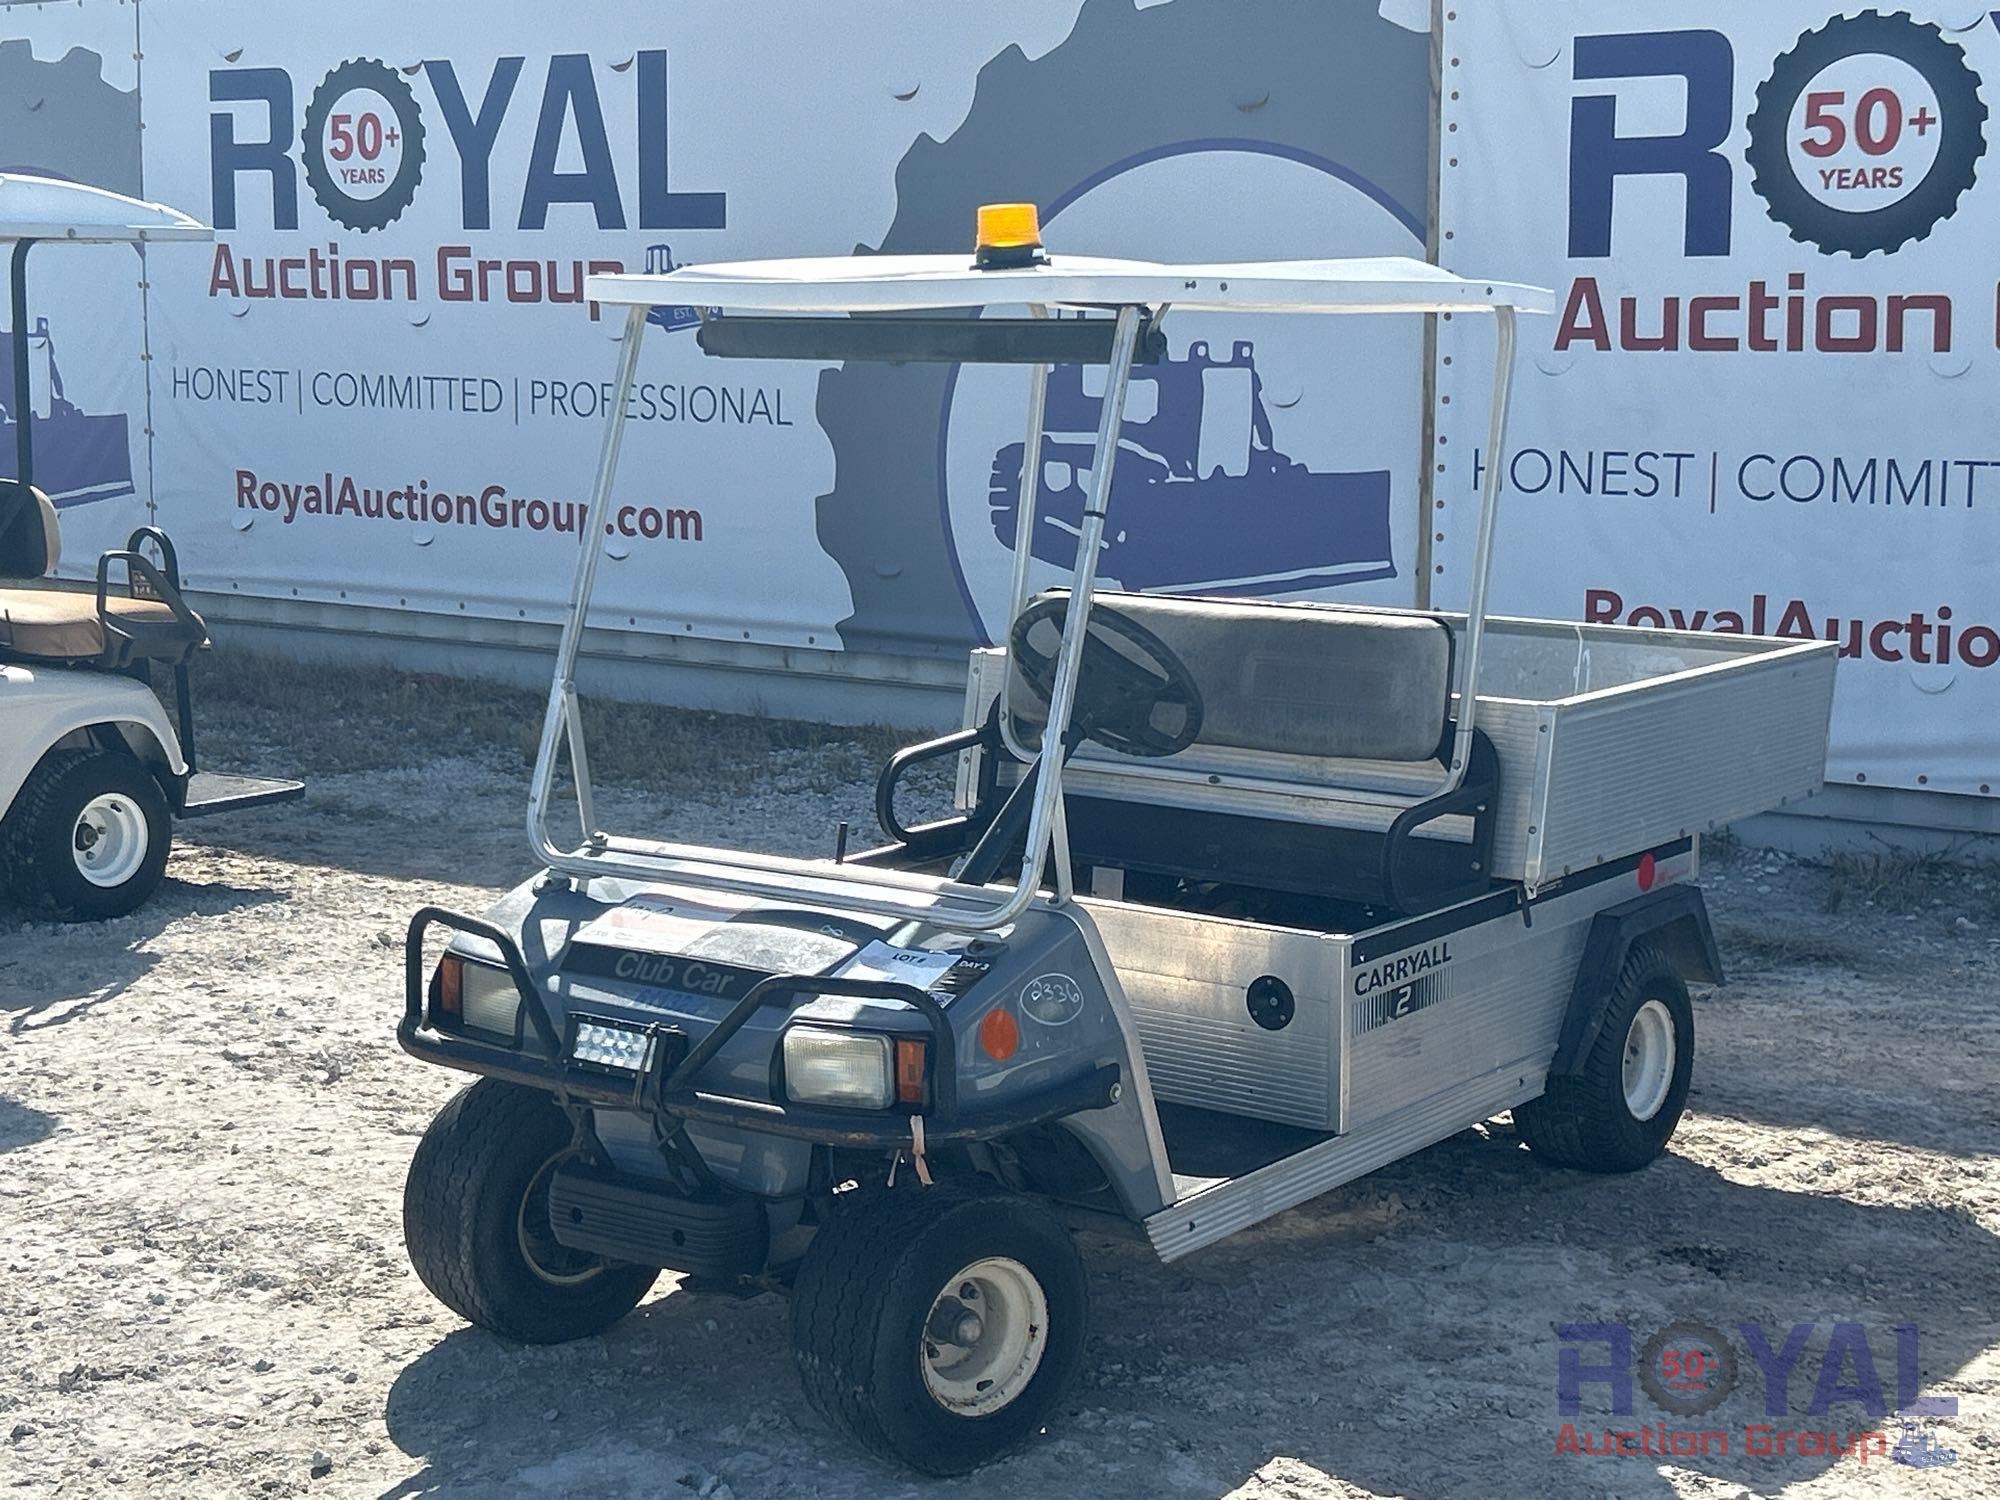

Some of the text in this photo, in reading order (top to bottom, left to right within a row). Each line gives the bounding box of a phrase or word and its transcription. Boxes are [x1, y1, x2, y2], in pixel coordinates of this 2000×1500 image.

[208, 49, 727, 233] ROYAL
[329, 112, 401, 162] 50+
[1800, 87, 1937, 158] 50+
[340, 166, 385, 185] YEARS
[1818, 166, 1903, 190] YEARS
[208, 242, 418, 301] Auction
[1553, 272, 1952, 353] Auction
[172, 367, 794, 426] HONEST COMMITTED PROFESSIONAL
[615, 952, 735, 995] Club Car
[891, 953, 918, 963] LOT
[958, 960, 982, 970] DAY
[1354, 942, 1452, 996] CARRYALL
[1395, 985, 1412, 1017] 2
